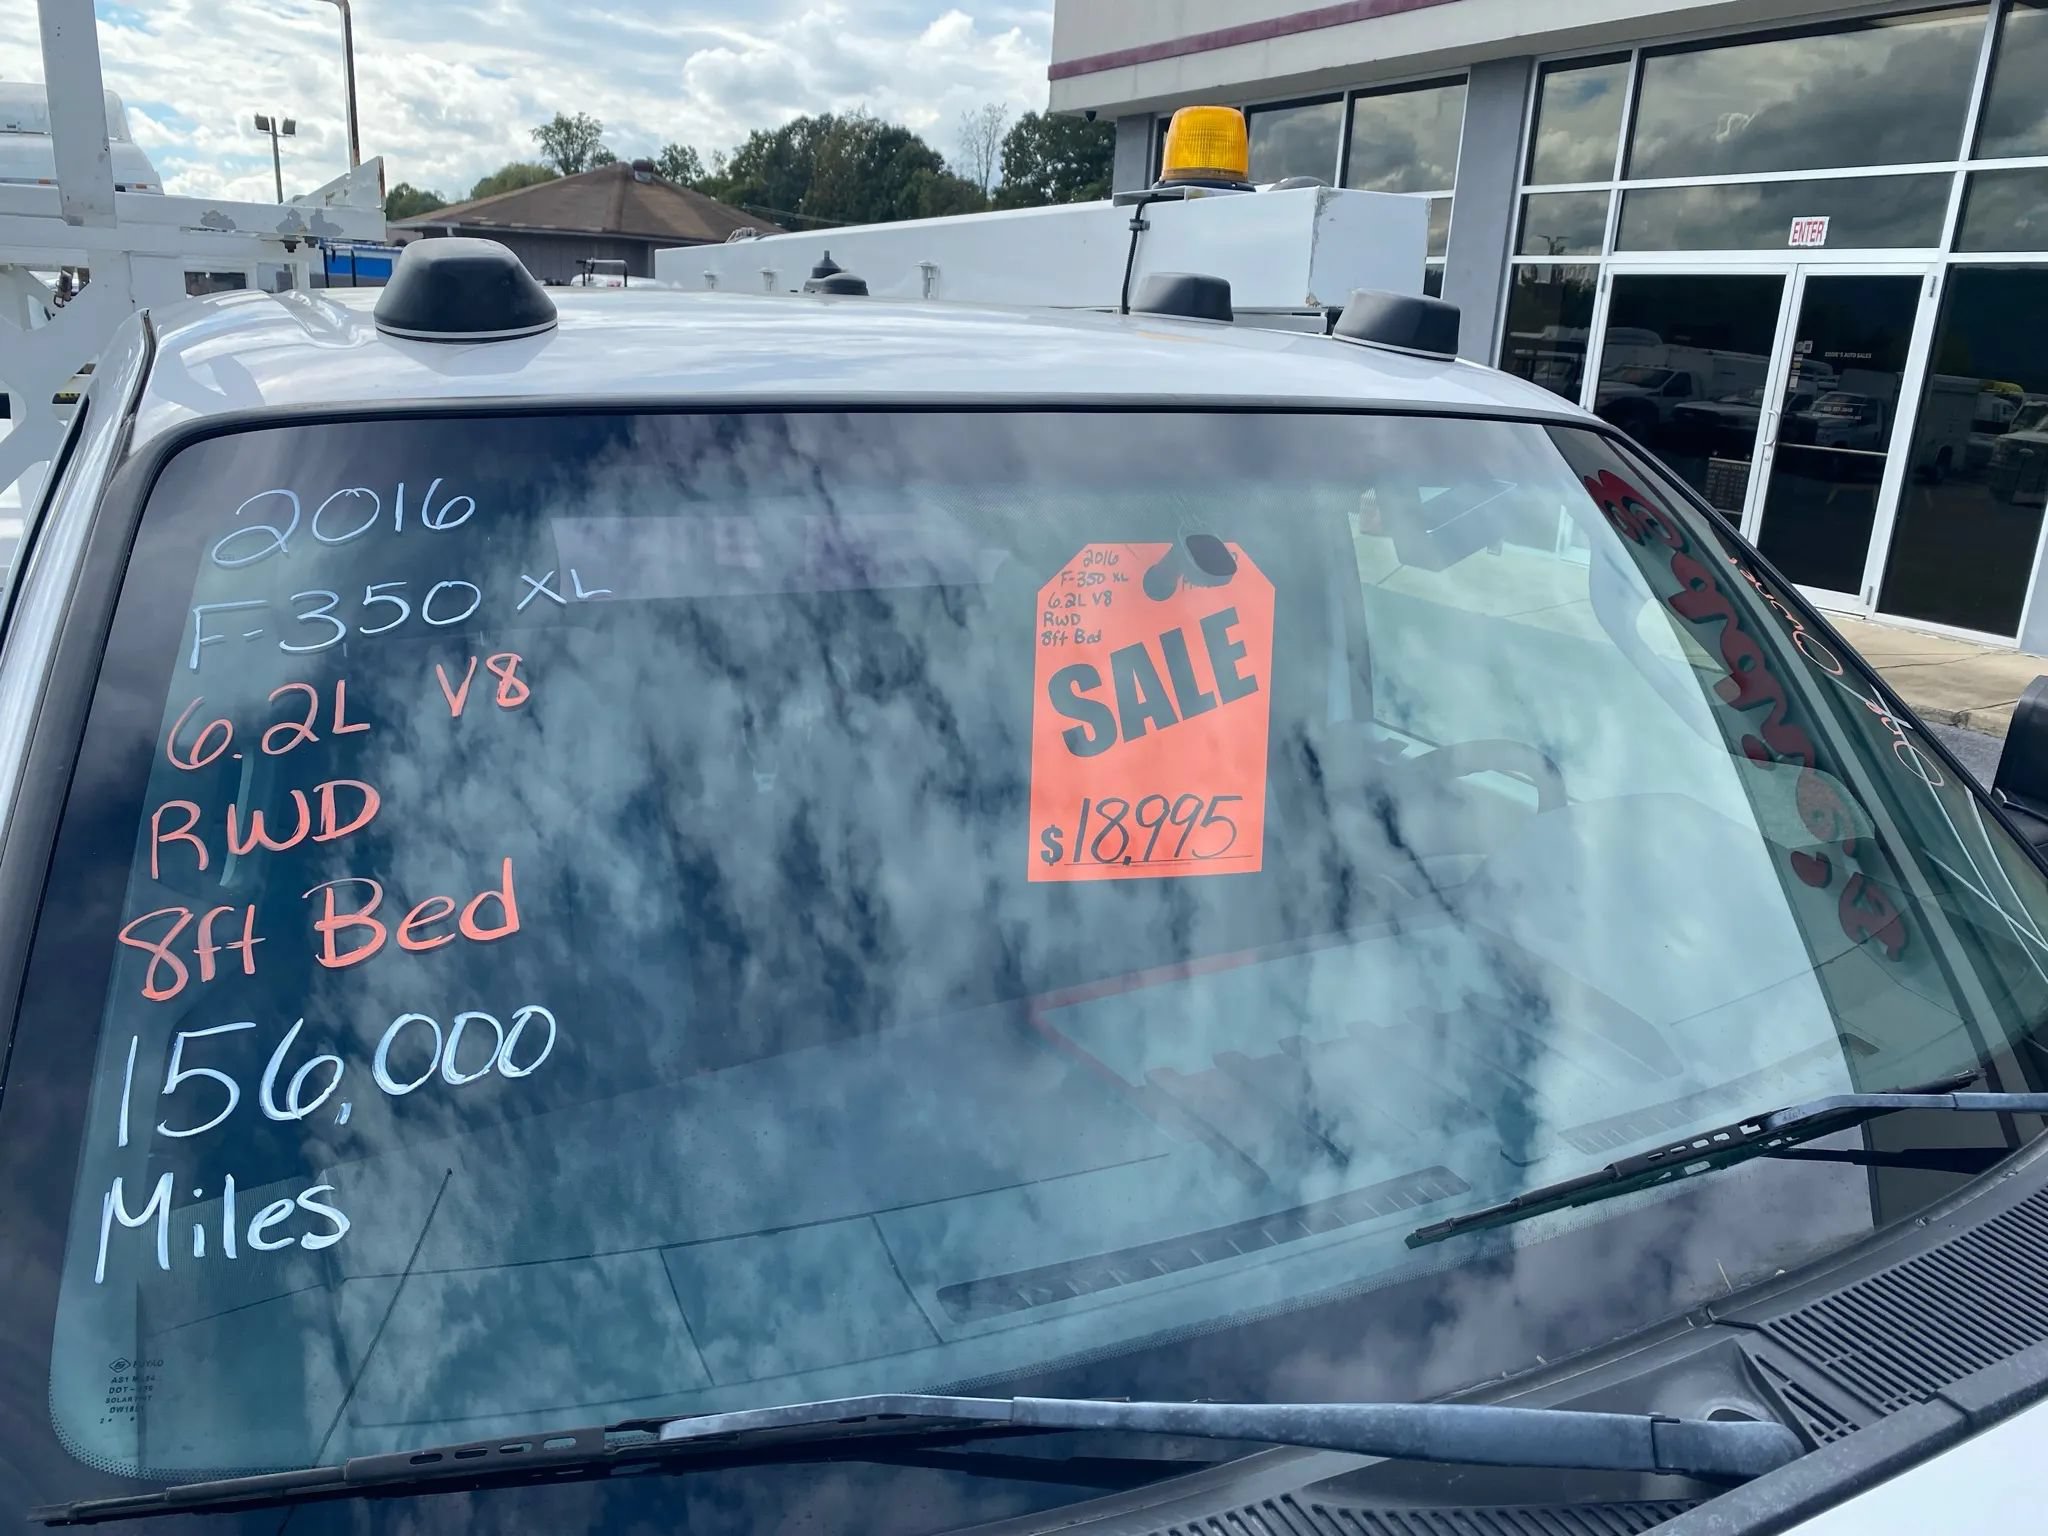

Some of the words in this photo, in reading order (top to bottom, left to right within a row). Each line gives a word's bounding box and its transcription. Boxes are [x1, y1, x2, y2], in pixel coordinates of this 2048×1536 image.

[1791, 221, 1825, 243] ENTER
[211, 478, 476, 566] 2016
[1082, 549, 1119, 568] 2016
[188, 580, 482, 670] F-350
[516, 568, 613, 611] XL
[1043, 611, 1081, 628] RWD
[1048, 591, 1087, 608] 6.2L
[1092, 590, 1112, 608] V8
[1061, 571, 1106, 588] F-350
[1112, 571, 1128, 583] XL
[1041, 629, 1069, 647] 8ft
[1074, 627, 1102, 645] Bed
[1048, 606, 1260, 758] SALE
[166, 678, 371, 771] 6.2L
[435, 652, 531, 718] V8
[151, 778, 381, 880] RWD
[118, 903, 266, 1001] 8ft
[302, 856, 520, 968] Bed
[118, 1004, 557, 1147] 156,000
[94, 1171, 351, 1285] Miles
